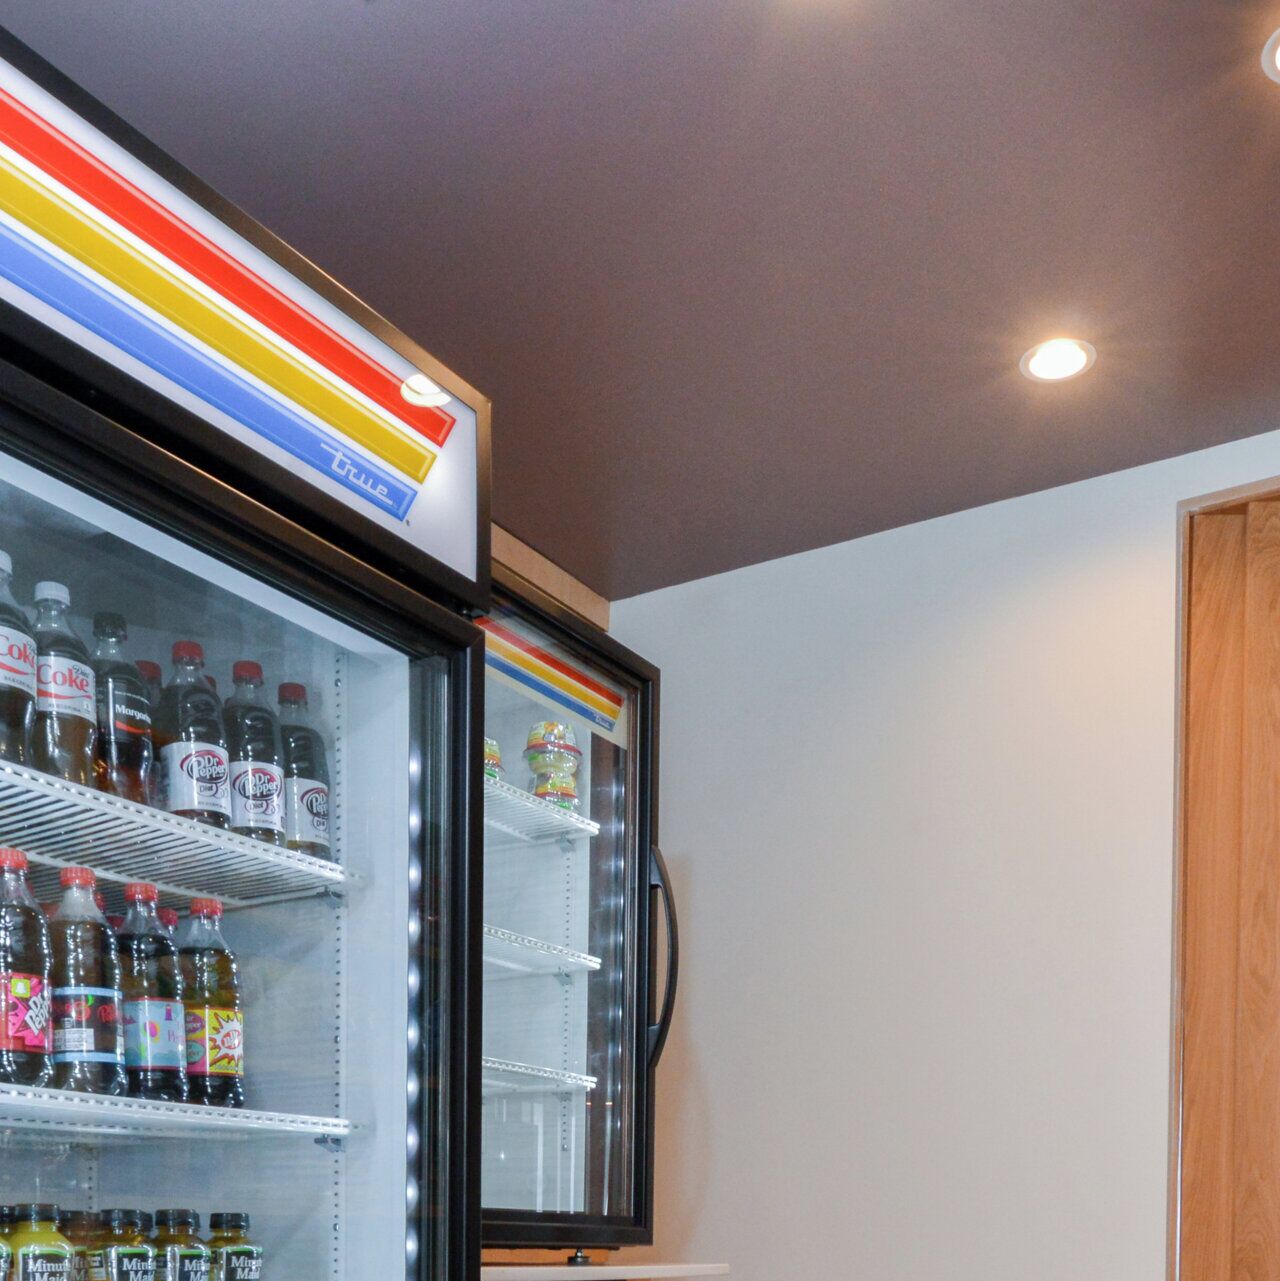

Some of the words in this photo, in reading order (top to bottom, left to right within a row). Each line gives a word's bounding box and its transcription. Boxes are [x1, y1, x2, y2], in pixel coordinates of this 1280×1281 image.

[37, 664, 89, 692] Coke
[191, 757, 227, 781] Pepper
[244, 776, 281, 798] Pepper
